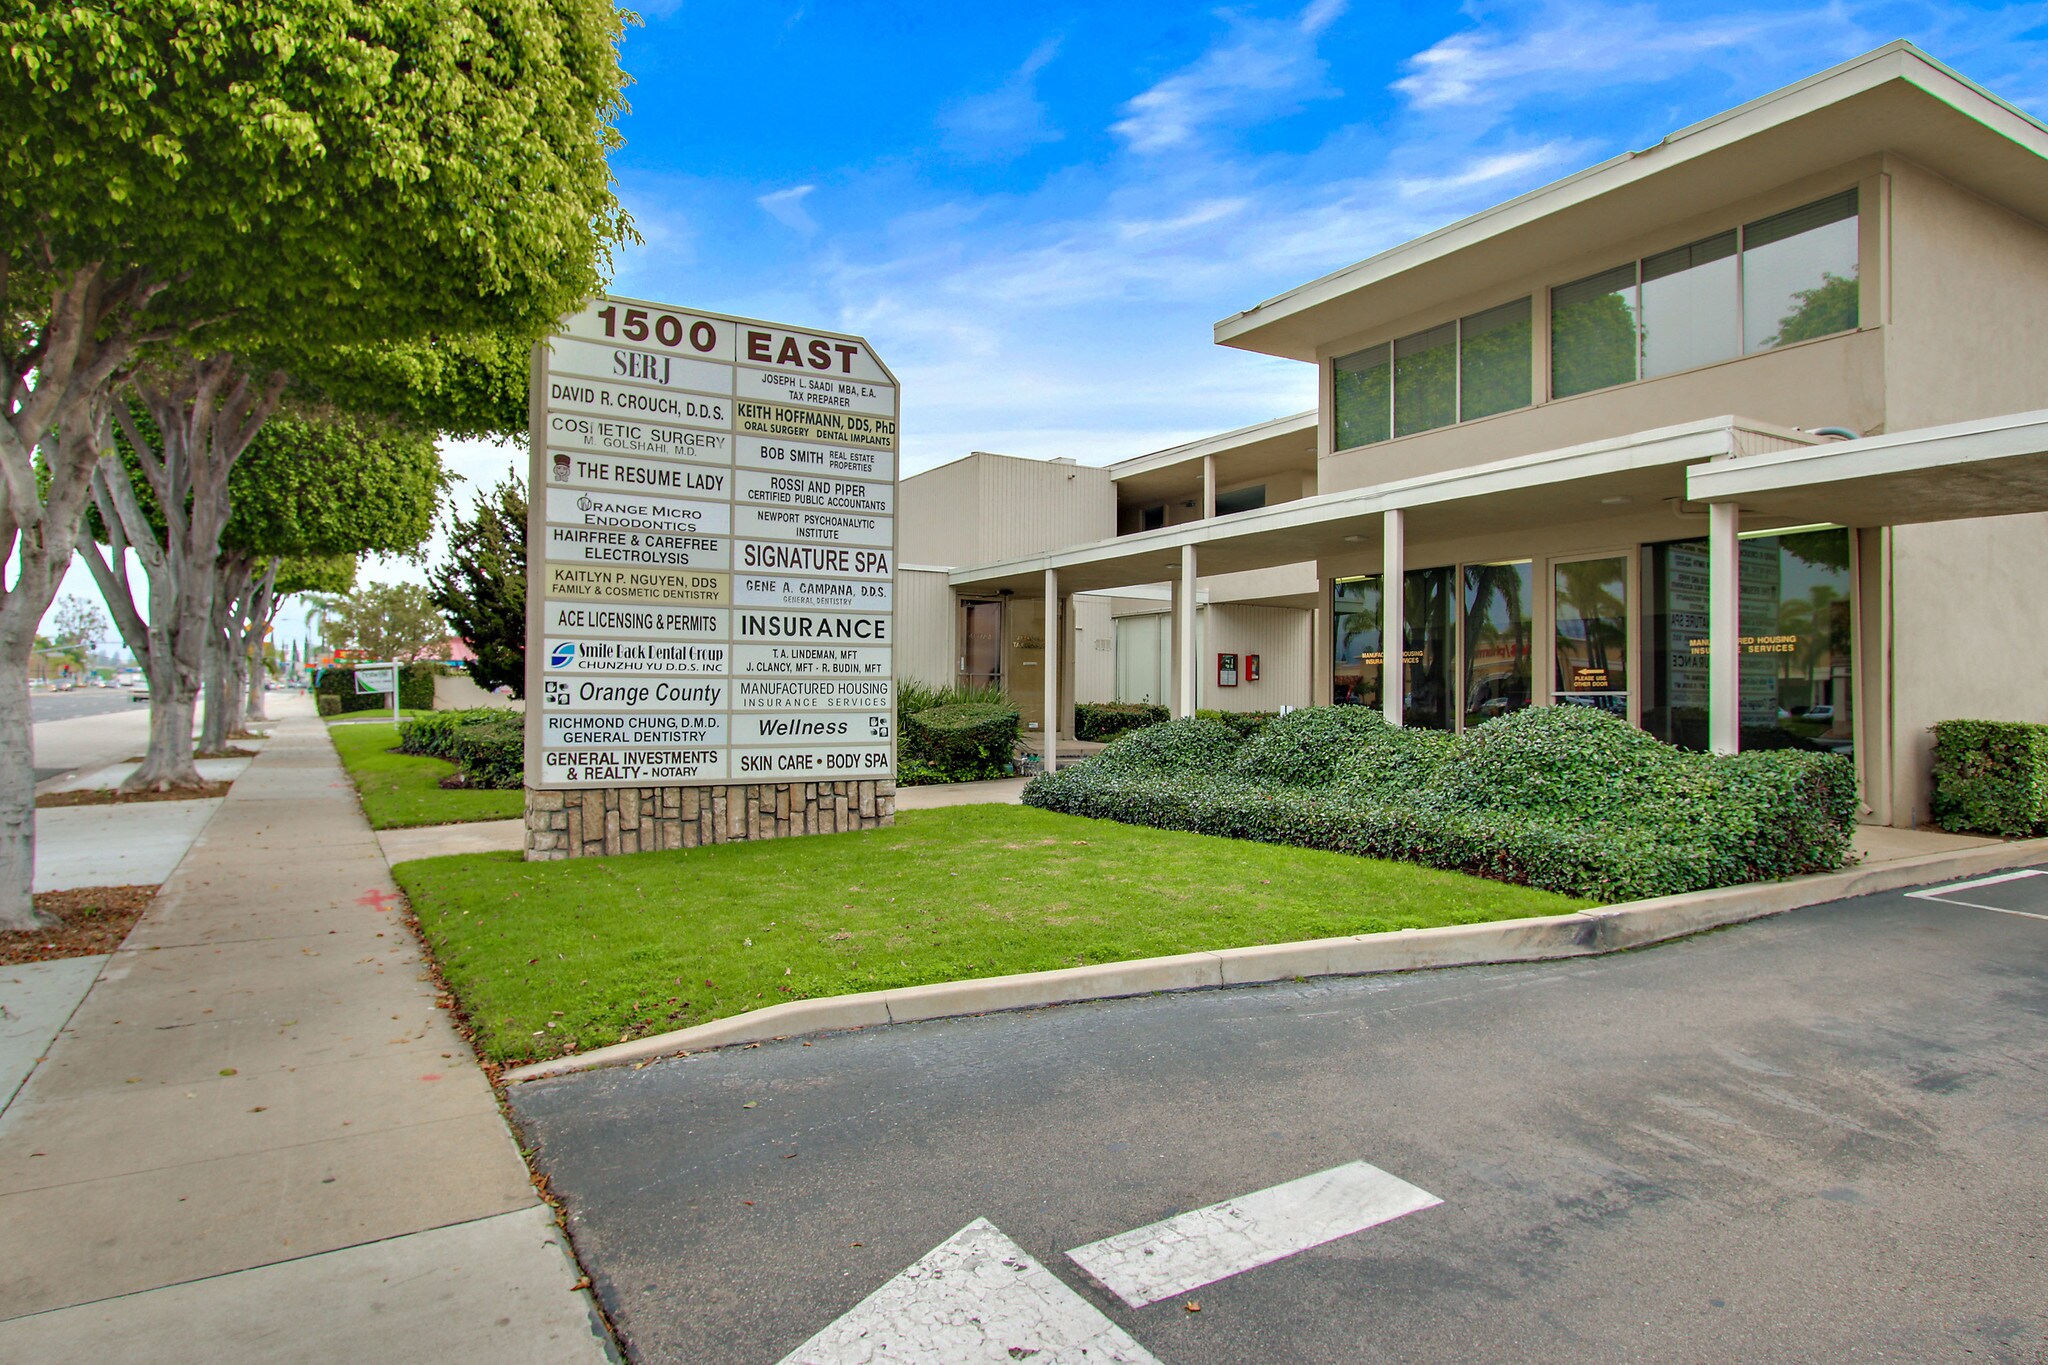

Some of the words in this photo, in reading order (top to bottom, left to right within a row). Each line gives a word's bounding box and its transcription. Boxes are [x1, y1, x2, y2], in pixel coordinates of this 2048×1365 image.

[598, 306, 717, 352] 1500
[748, 331, 857, 373] EAST
[613, 350, 671, 385] SERJ
[762, 374, 795, 387] JOSEPH
[799, 380, 807, 389] L.
[809, 380, 833, 391] SAADI
[839, 384, 859, 396] MBA,
[862, 388, 876, 398] E.A.
[552, 384, 594, 403] DAVID
[601, 393, 613, 406] R.
[618, 394, 681, 417] CROUCH,
[687, 402, 724, 420] D.D.S.
[789, 391, 803, 401] TAX
[807, 394, 850, 407] PREPARER
[738, 403, 771, 419] KEITH
[776, 409, 844, 429] HOFFMANN,
[848, 418, 872, 432] DDS,
[875, 420, 895, 433] PhD
[651, 430, 725, 448] SURGERY
[744, 421, 767, 432] ORAL
[771, 424, 809, 436] SURGERY
[816, 430, 848, 441] DENTAL
[850, 434, 890, 446] IMPLANTS
[584, 436, 596, 445] M.
[604, 438, 669, 454] GOLSHAHI,
[675, 446, 697, 456] M.D.
[761, 446, 784, 459] BOB
[790, 450, 824, 464] SMITH
[830, 451, 847, 460] REAL
[850, 453, 874, 463] ESTATE
[830, 459, 872, 472] PROPERTIES
[577, 462, 609, 480] THE
[615, 465, 681, 487] RESUME
[687, 472, 723, 491] LADY
[771, 477, 804, 491] ROSSI
[808, 483, 830, 494] AND
[835, 483, 865, 497] PIPER
[748, 489, 791, 502] CERTIFIED
[795, 494, 825, 505] PUBLIC
[828, 497, 886, 511] ACCOUNTANTS
[585, 514, 697, 532] ENDODONTICS
[758, 511, 800, 523] NEWPORT
[805, 515, 875, 529] PSYCHOANALYTIC
[554, 529, 626, 545] HAIRFREE
[631, 535, 640, 546] &
[646, 536, 718, 551] CAREFREE
[796, 528, 839, 539] INSTITUTE
[585, 547, 689, 564] ELECTROLYSIS
[744, 544, 849, 571] SIGNATURE
[855, 551, 888, 573] SPA
[555, 569, 612, 583] KAITLYN
[616, 574, 626, 584] P.
[630, 575, 688, 588] NGUYEN,
[691, 578, 717, 588] DDS
[552, 584, 591, 594] FAMILY
[595, 586, 601, 594] &
[605, 587, 660, 597] COSMETIC
[663, 590, 720, 600] DENTISTRY
[746, 580, 776, 592] GENE
[783, 582, 793, 593] A.
[800, 583, 856, 596] CAMPANA,
[861, 586, 886, 598] D.D.S.
[559, 610, 584, 627] ACE
[589, 611, 653, 629] LICENSING
[656, 614, 664, 629] &
[667, 615, 717, 631] PERMITS
[742, 615, 885, 639] INSURANCE
[1748, 644, 1795, 652] SERVICES
[1757, 635, 1796, 644] HOUSING
[579, 643, 613, 658] Smile
[781, 650, 789, 658] A.
[792, 650, 837, 660] LINDEMAN,
[841, 651, 857, 659] MFT
[579, 661, 643, 670] CHUNZHU
[666, 663, 699, 671] D.D.S.
[746, 662, 754, 672] J.
[757, 663, 792, 673] CLANCY,
[796, 663, 813, 672] MFT
[822, 664, 830, 672] R.
[833, 664, 861, 674] BUDIN,
[865, 664, 881, 673] MFT
[580, 682, 649, 705] Orange
[655, 683, 721, 706] County
[740, 683, 835, 694] MANUFACTURED
[838, 683, 888, 694] HOUSING
[744, 699, 817, 707] INSURANCE
[828, 698, 886, 706] SERVICES
[549, 717, 624, 729] RICHMOND
[628, 717, 678, 730] CHUNG,
[681, 717, 720, 728] D.M.D.
[759, 719, 848, 735] Wellness
[563, 732, 629, 743] GENERAL
[634, 731, 707, 742] DENTISTRY
[547, 752, 619, 766] GENERAL
[624, 750, 718, 764] INVESTMENTS
[741, 755, 772, 771] SKIN
[778, 755, 813, 770] CARE
[827, 754, 861, 769] BODY
[865, 753, 888, 768] SPA
[567, 767, 578, 780] &
[585, 766, 641, 780] REALTY
[652, 767, 698, 777] NOTARY
